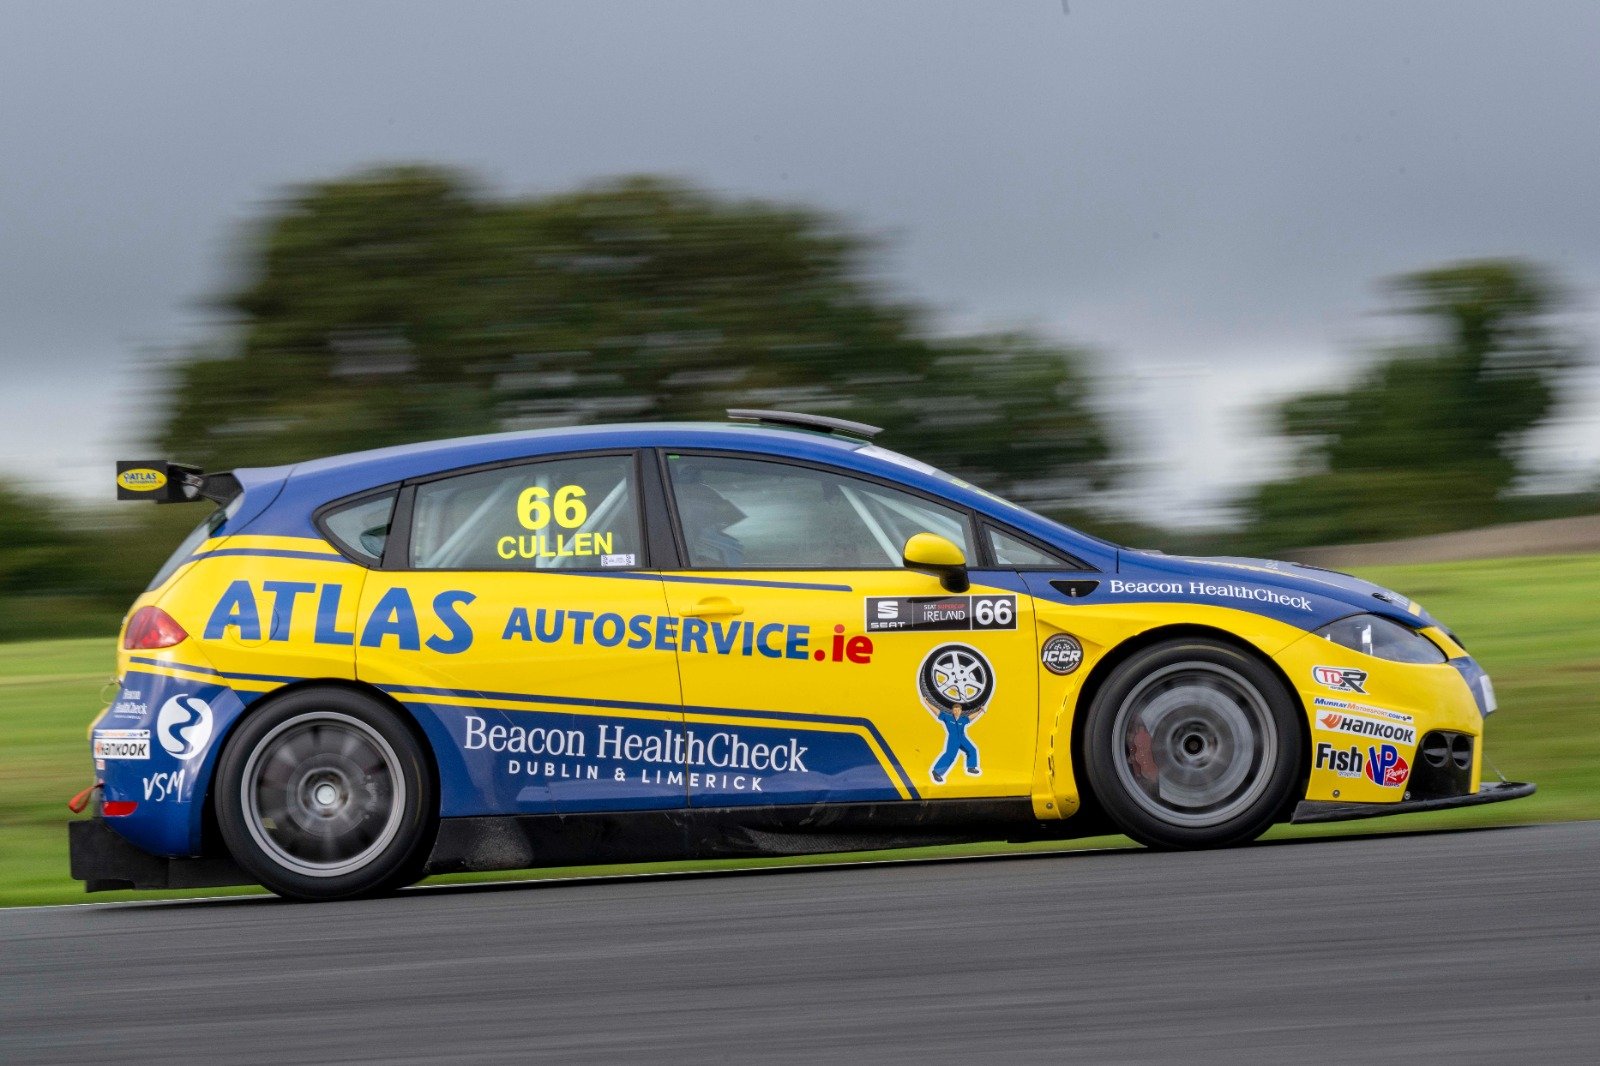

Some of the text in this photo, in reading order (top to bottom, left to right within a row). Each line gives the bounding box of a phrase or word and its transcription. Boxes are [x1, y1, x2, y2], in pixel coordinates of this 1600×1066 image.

[129, 472, 156, 480] ATLAS
[517, 485, 588, 530] 66
[497, 532, 613, 560] CULLEN
[1110, 580, 1312, 611] Beacon HealthCheck
[203, 580, 874, 665] ATLAS AUTOSERVICE.ie
[870, 621, 906, 629] SEAT
[923, 610, 966, 623] IRELAND
[975, 599, 1013, 626] 66
[1042, 650, 1082, 662] ICCR
[1318, 669, 1368, 694] TDR
[464, 715, 808, 773] Beacon HealthCheck
[508, 760, 763, 791] DUBLIN & LIMERICK
[1369, 744, 1398, 786] VP
[142, 768, 186, 803] VSM
